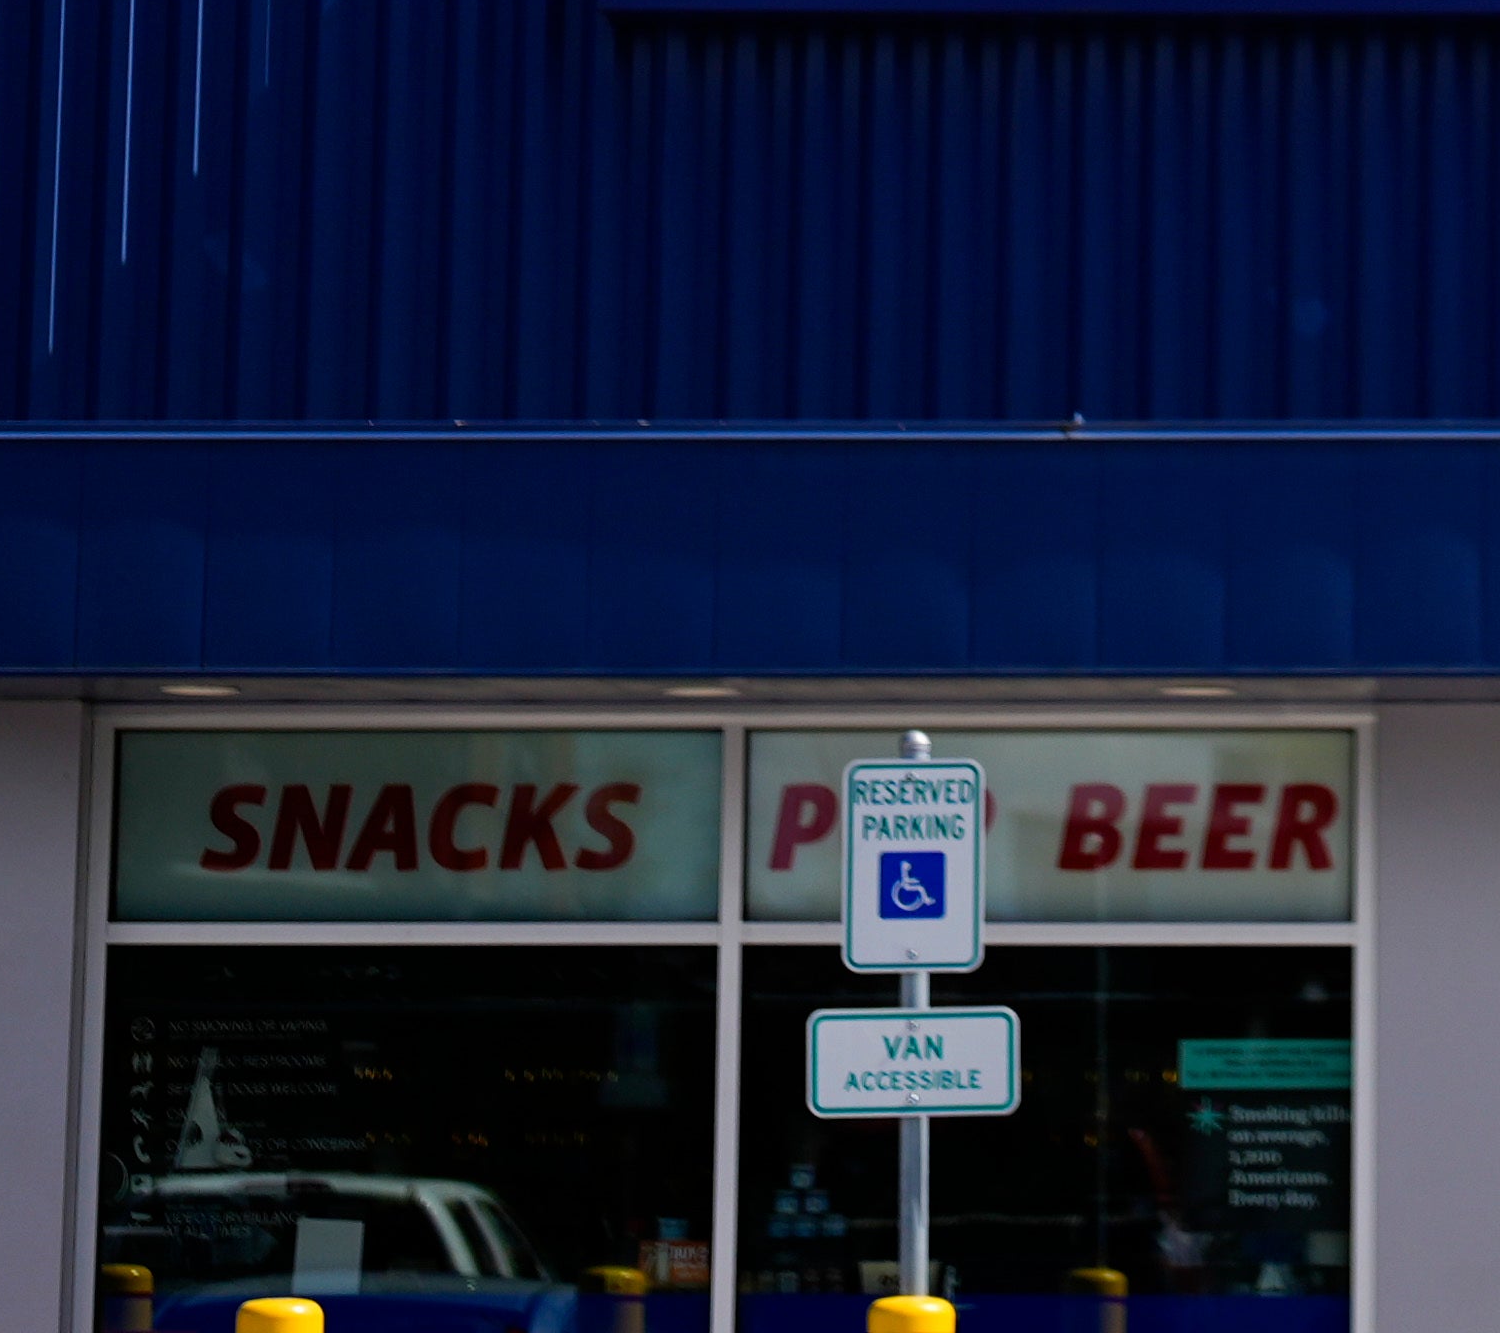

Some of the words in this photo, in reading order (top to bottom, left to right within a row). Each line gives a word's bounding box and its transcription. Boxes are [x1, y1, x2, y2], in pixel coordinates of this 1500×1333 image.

[854, 779, 976, 805] RESERVED
[201, 783, 641, 870] SNACKS
[862, 813, 966, 840] PARKING
[1058, 784, 1340, 870] BEER
[882, 1035, 944, 1061] VAN
[844, 1069, 982, 1091] ACCESSIBLE
